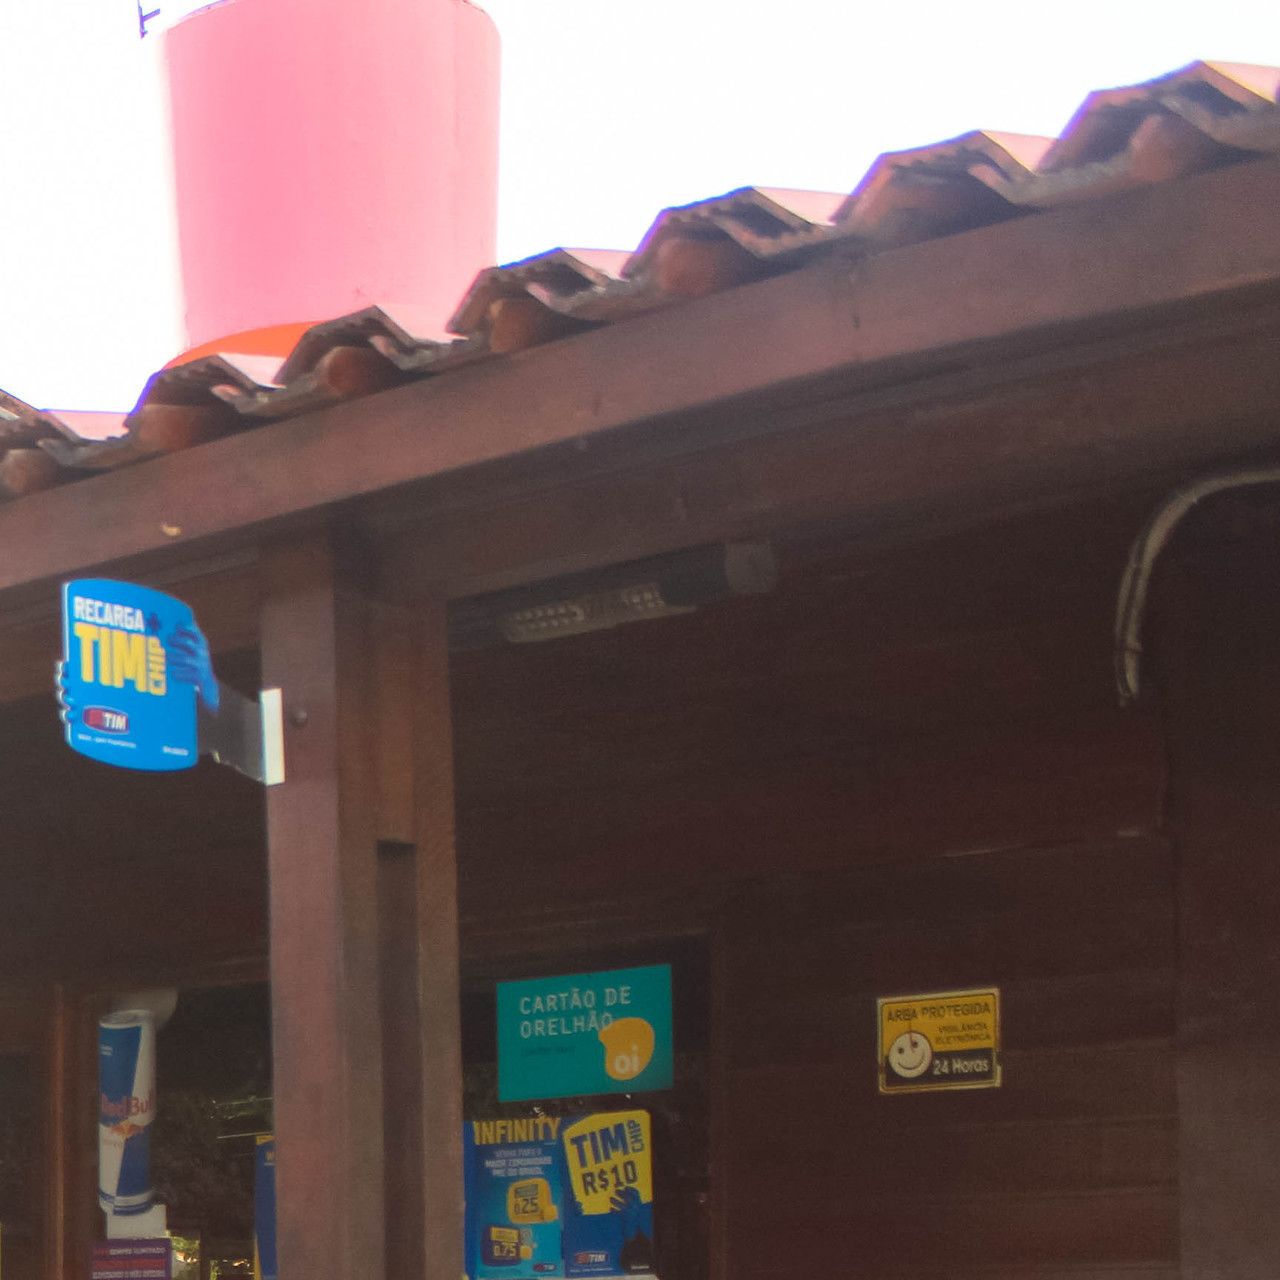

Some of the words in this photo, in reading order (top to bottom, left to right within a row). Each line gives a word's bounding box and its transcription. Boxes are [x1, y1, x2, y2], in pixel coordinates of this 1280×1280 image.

[73, 595, 145, 633] RECARGA
[74, 621, 147, 692] TIM
[103, 711, 127, 731] TIM
[519, 986, 596, 1015] CARTÃO
[603, 985, 632, 1006] DE
[921, 1002, 991, 1018] PROTEGIDA
[520, 1009, 614, 1039] ORELHÃO
[613, 1041, 641, 1075] oi
[932, 1060, 949, 1075] 24
[952, 1058, 989, 1074] Horas
[473, 1116, 561, 1146] INFINITY
[570, 1122, 633, 1170] TIM
[581, 1159, 638, 1197] R$10
[589, 1253, 606, 1265] TIM
